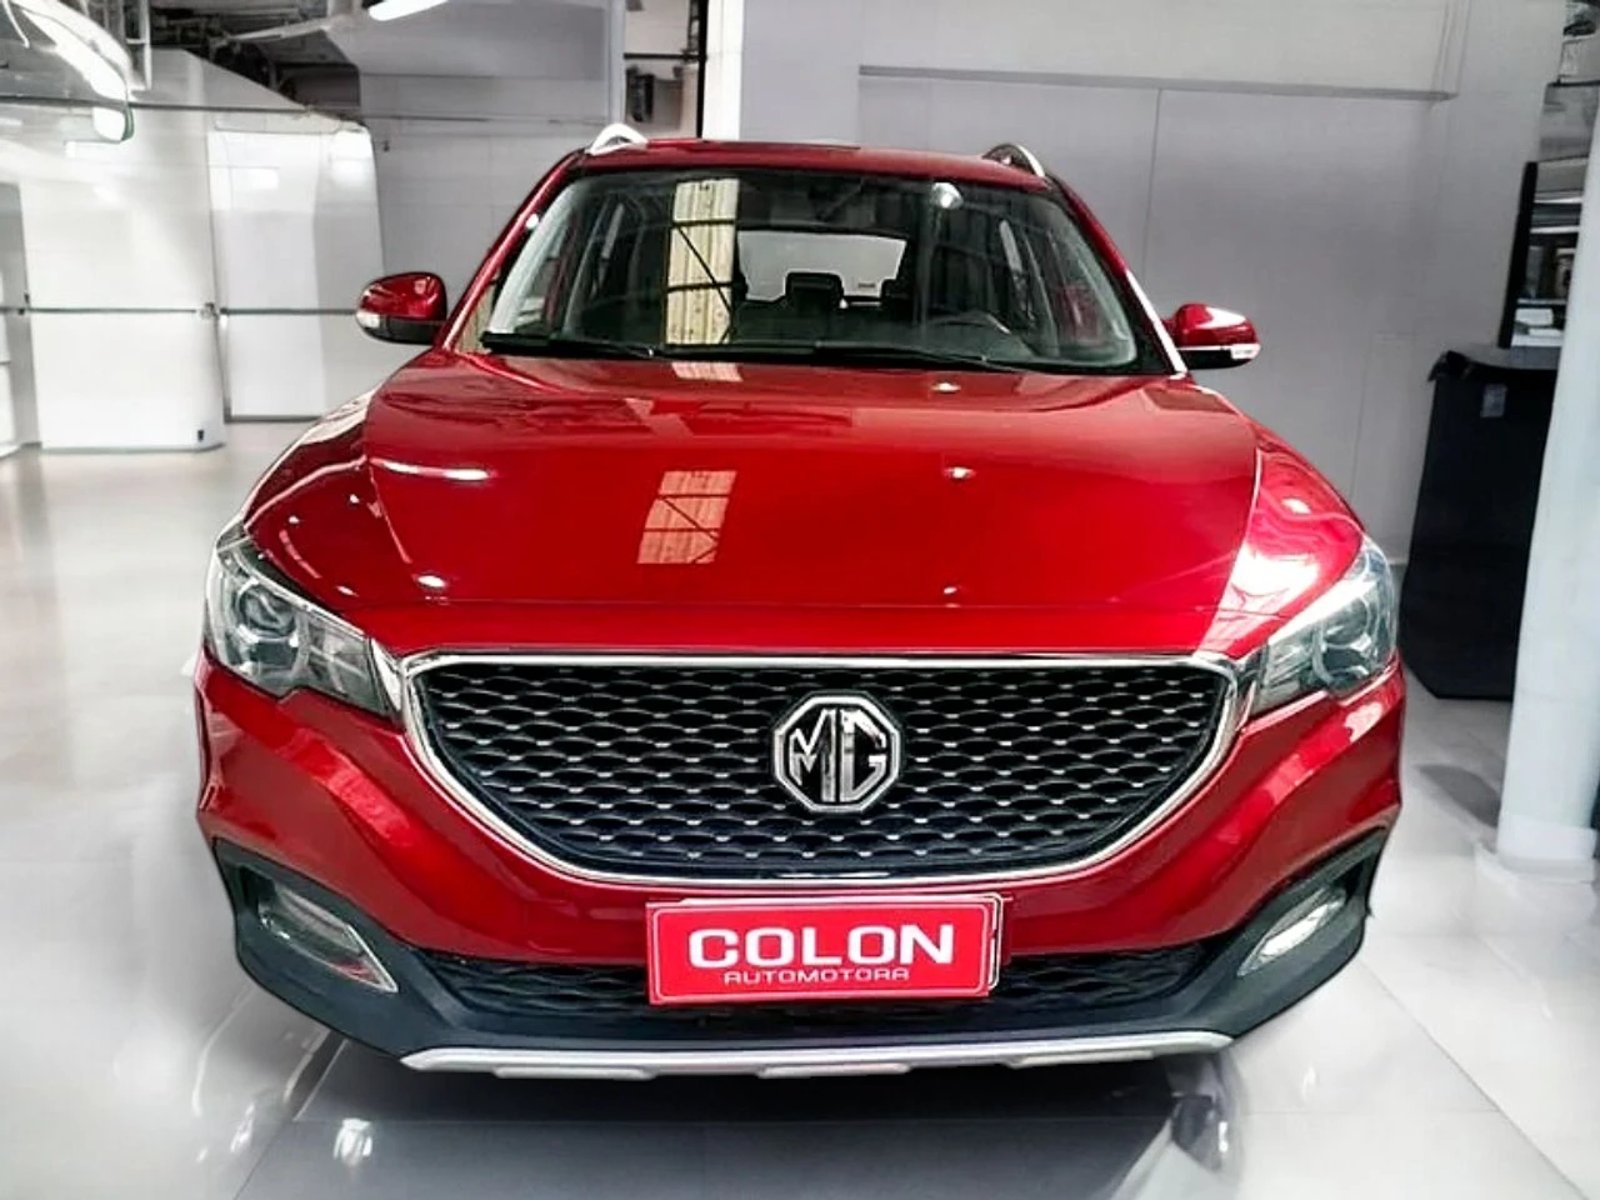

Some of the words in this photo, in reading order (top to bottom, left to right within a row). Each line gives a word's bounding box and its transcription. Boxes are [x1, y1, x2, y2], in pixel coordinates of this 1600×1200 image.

[788, 707, 887, 803] MG
[688, 923, 955, 969] COLON
[723, 967, 910, 985] AUTOMOTORA
